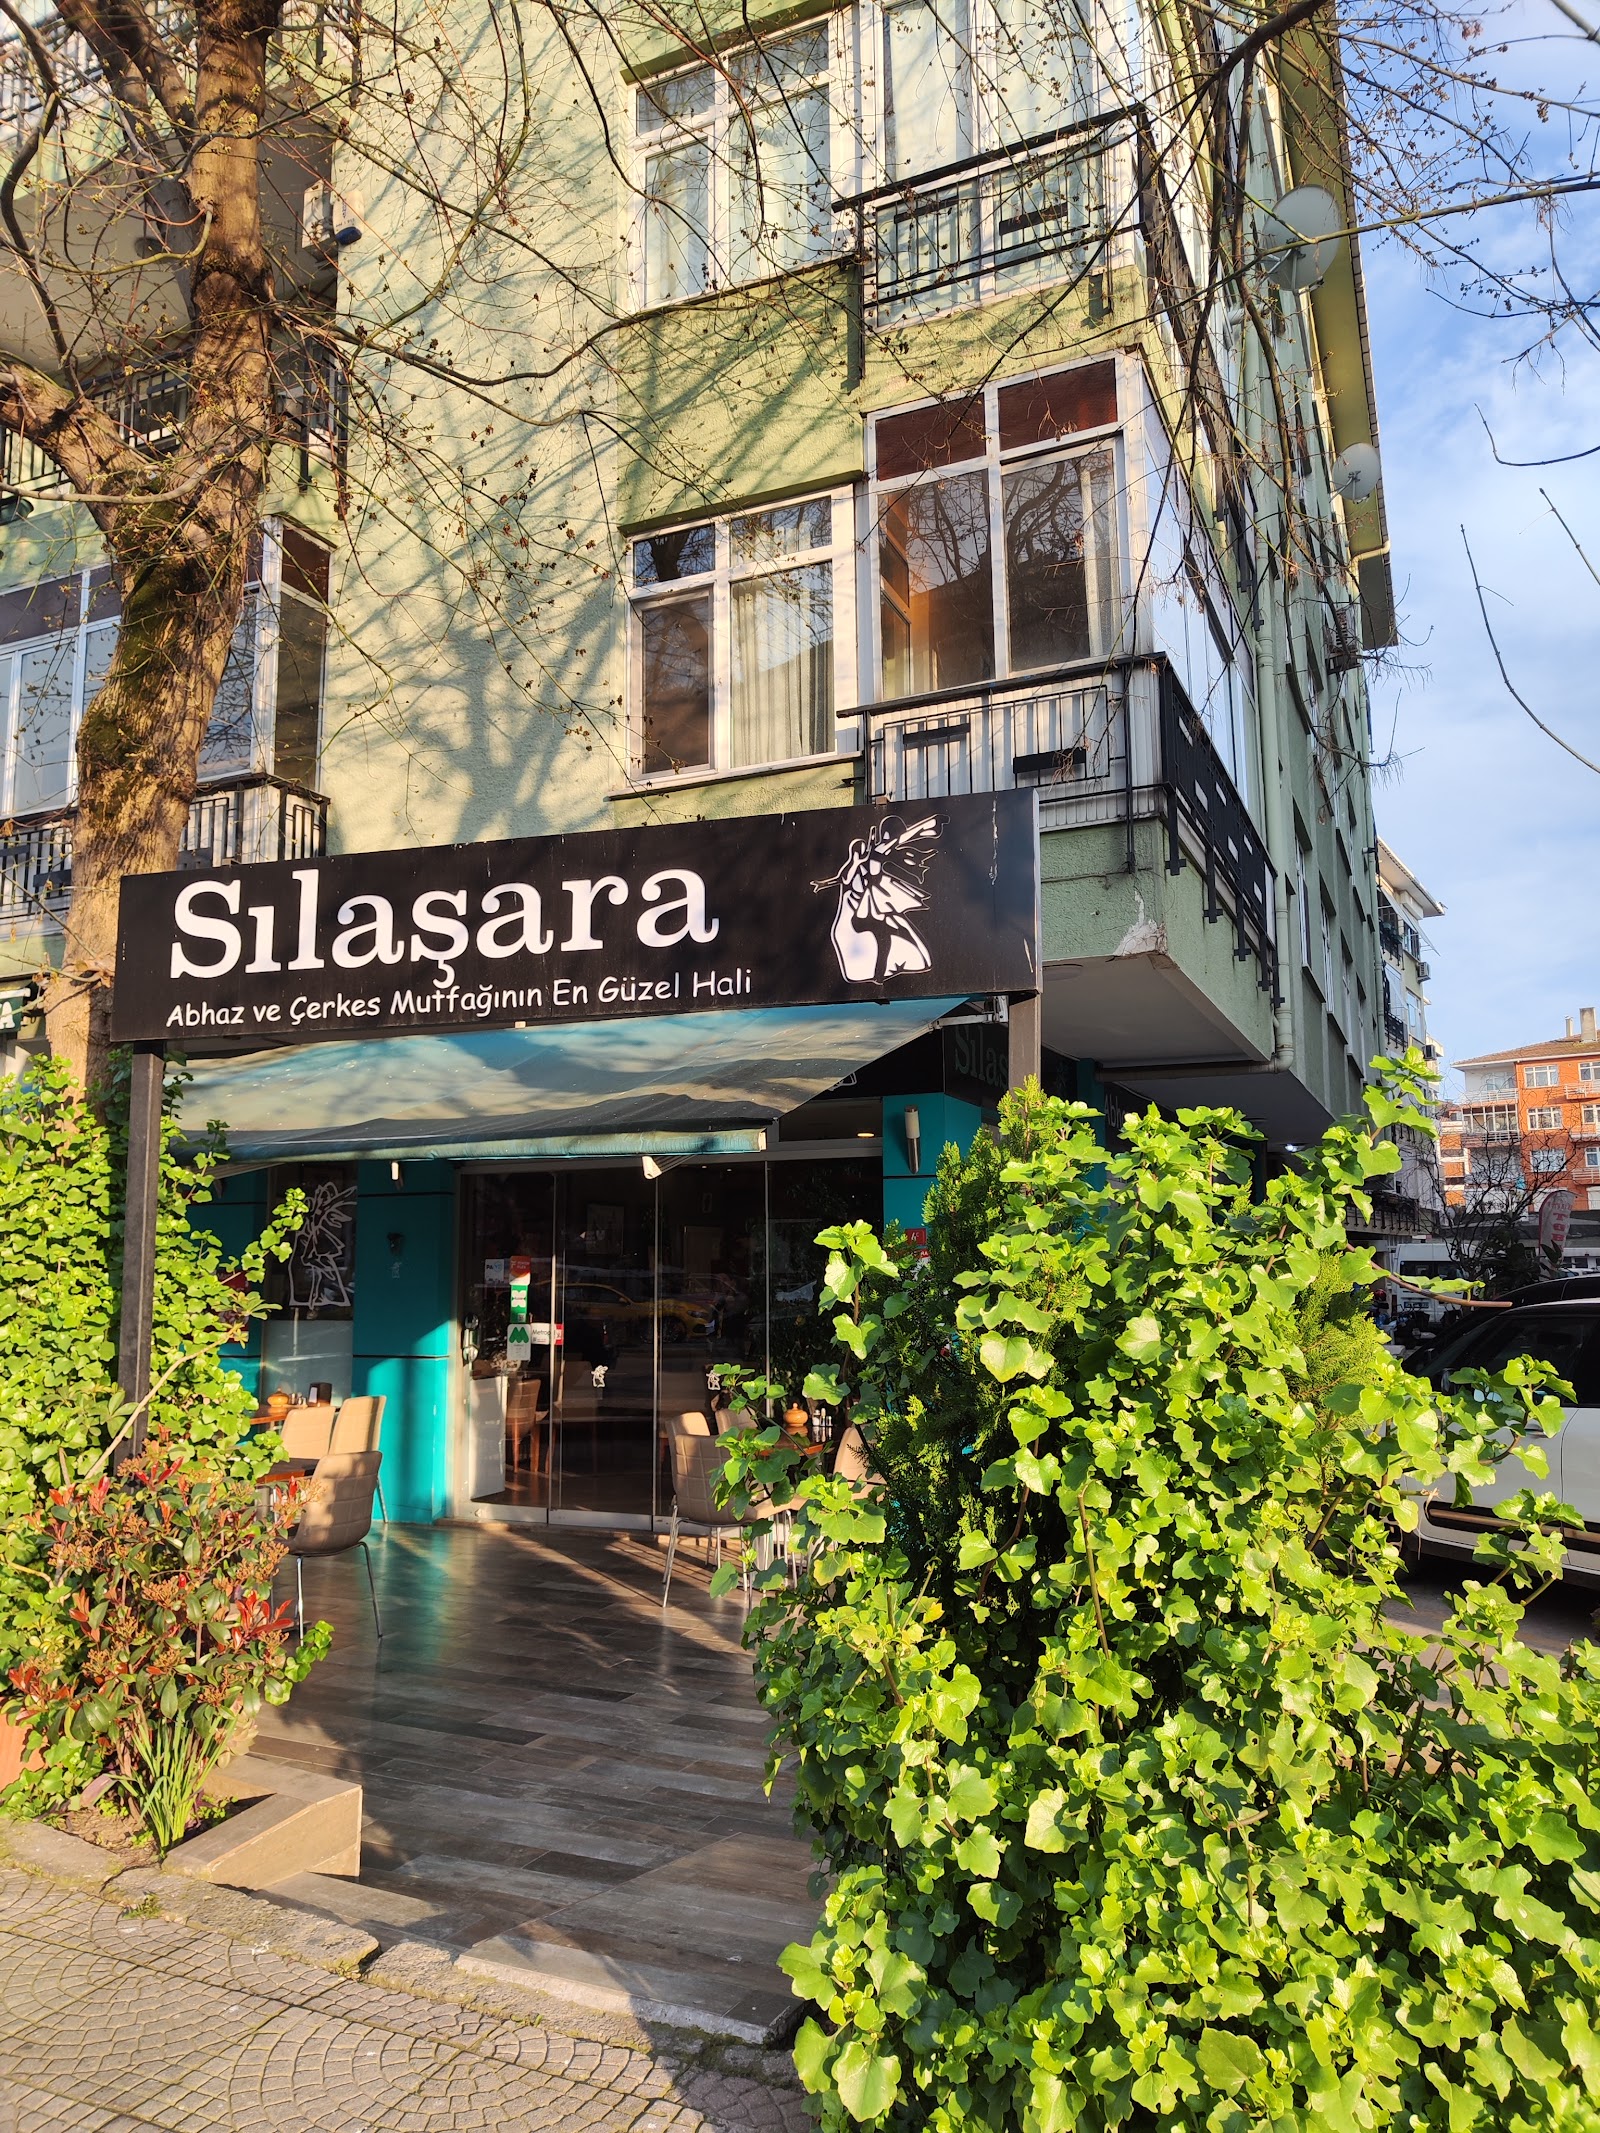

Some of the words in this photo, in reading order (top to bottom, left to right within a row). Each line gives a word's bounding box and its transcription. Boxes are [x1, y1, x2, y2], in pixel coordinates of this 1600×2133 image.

[171, 869, 719, 988] Sılaşara
[166, 1001, 245, 1027] Abhaz
[253, 1004, 282, 1023] ve
[290, 992, 381, 1025] Çerkes
[390, 985, 543, 1018] Mutfağının
[553, 979, 589, 1006] En
[598, 972, 681, 1003] Güzel
[693, 968, 752, 998] Hali
[532, 1329, 556, 1338] Metropl
